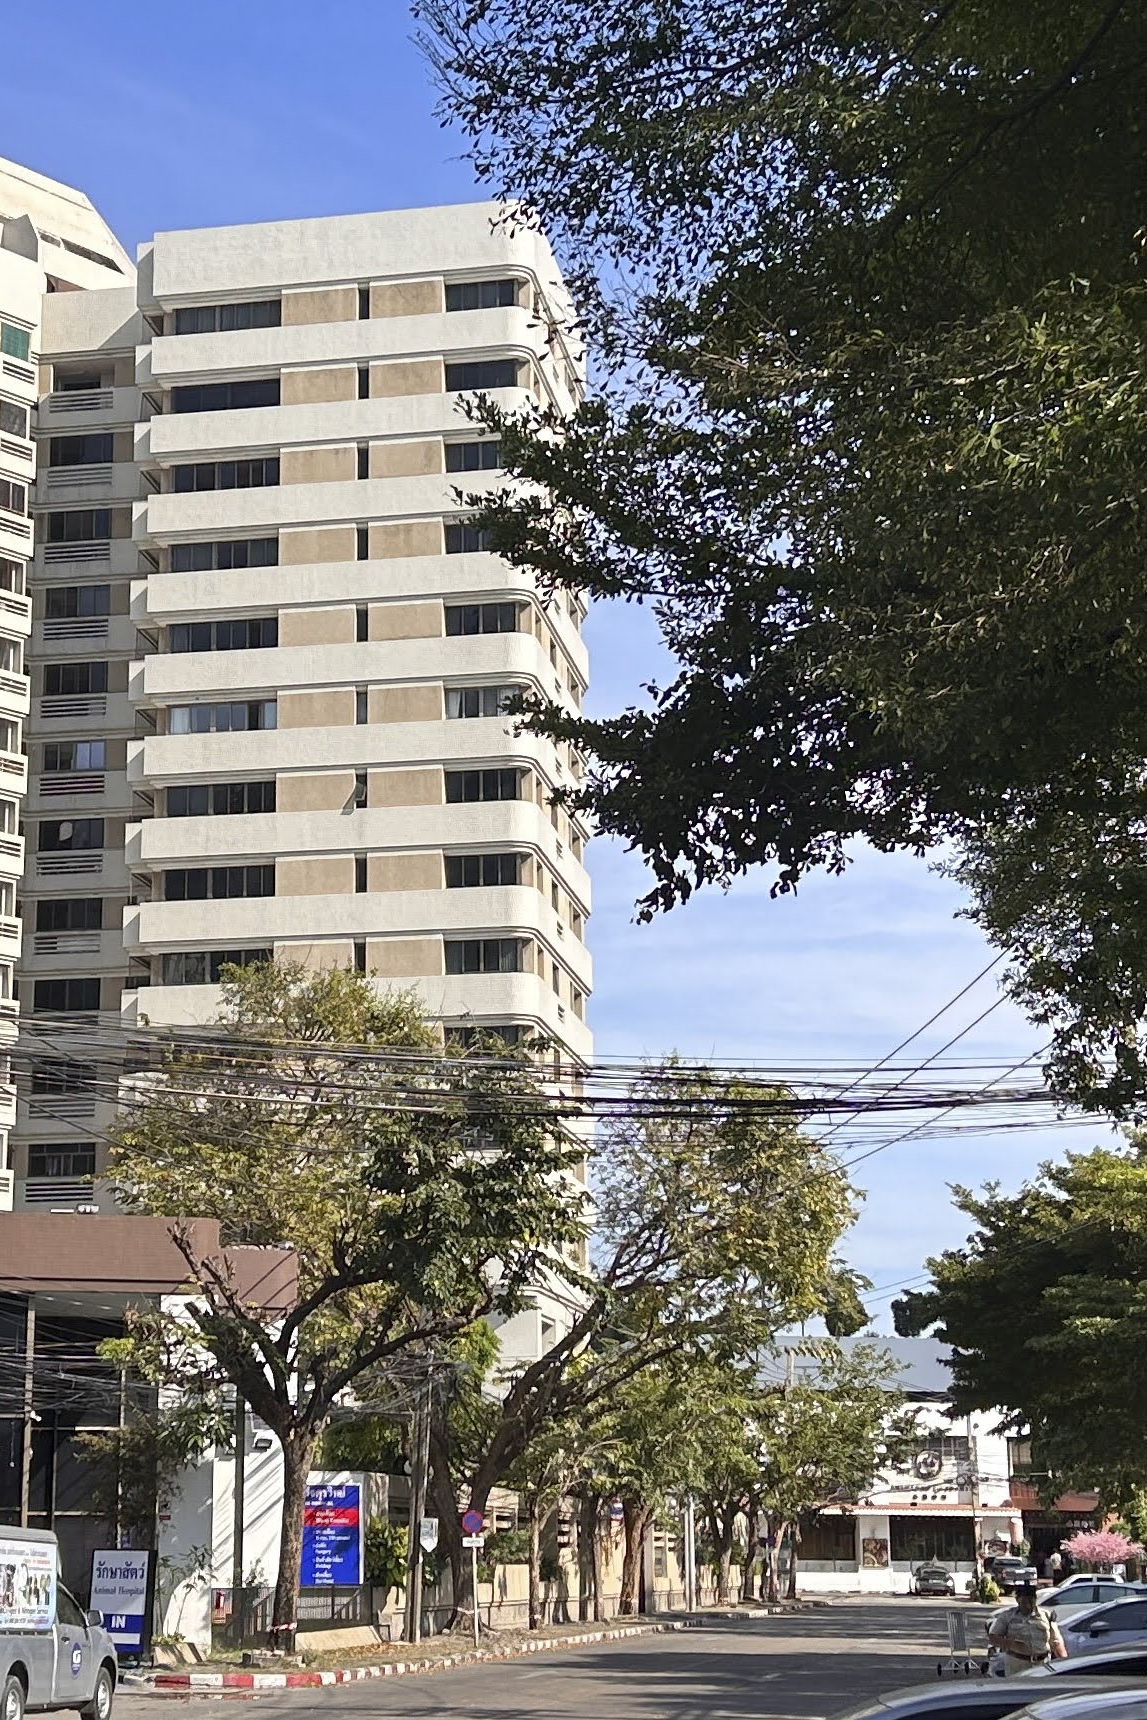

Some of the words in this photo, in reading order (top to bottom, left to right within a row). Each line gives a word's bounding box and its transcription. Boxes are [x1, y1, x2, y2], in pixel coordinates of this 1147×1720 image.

[96, 1560, 146, 1579] รักษาสัตว์
[118, 1586, 145, 1597] Hospital
[111, 1615, 127, 1629] IN
